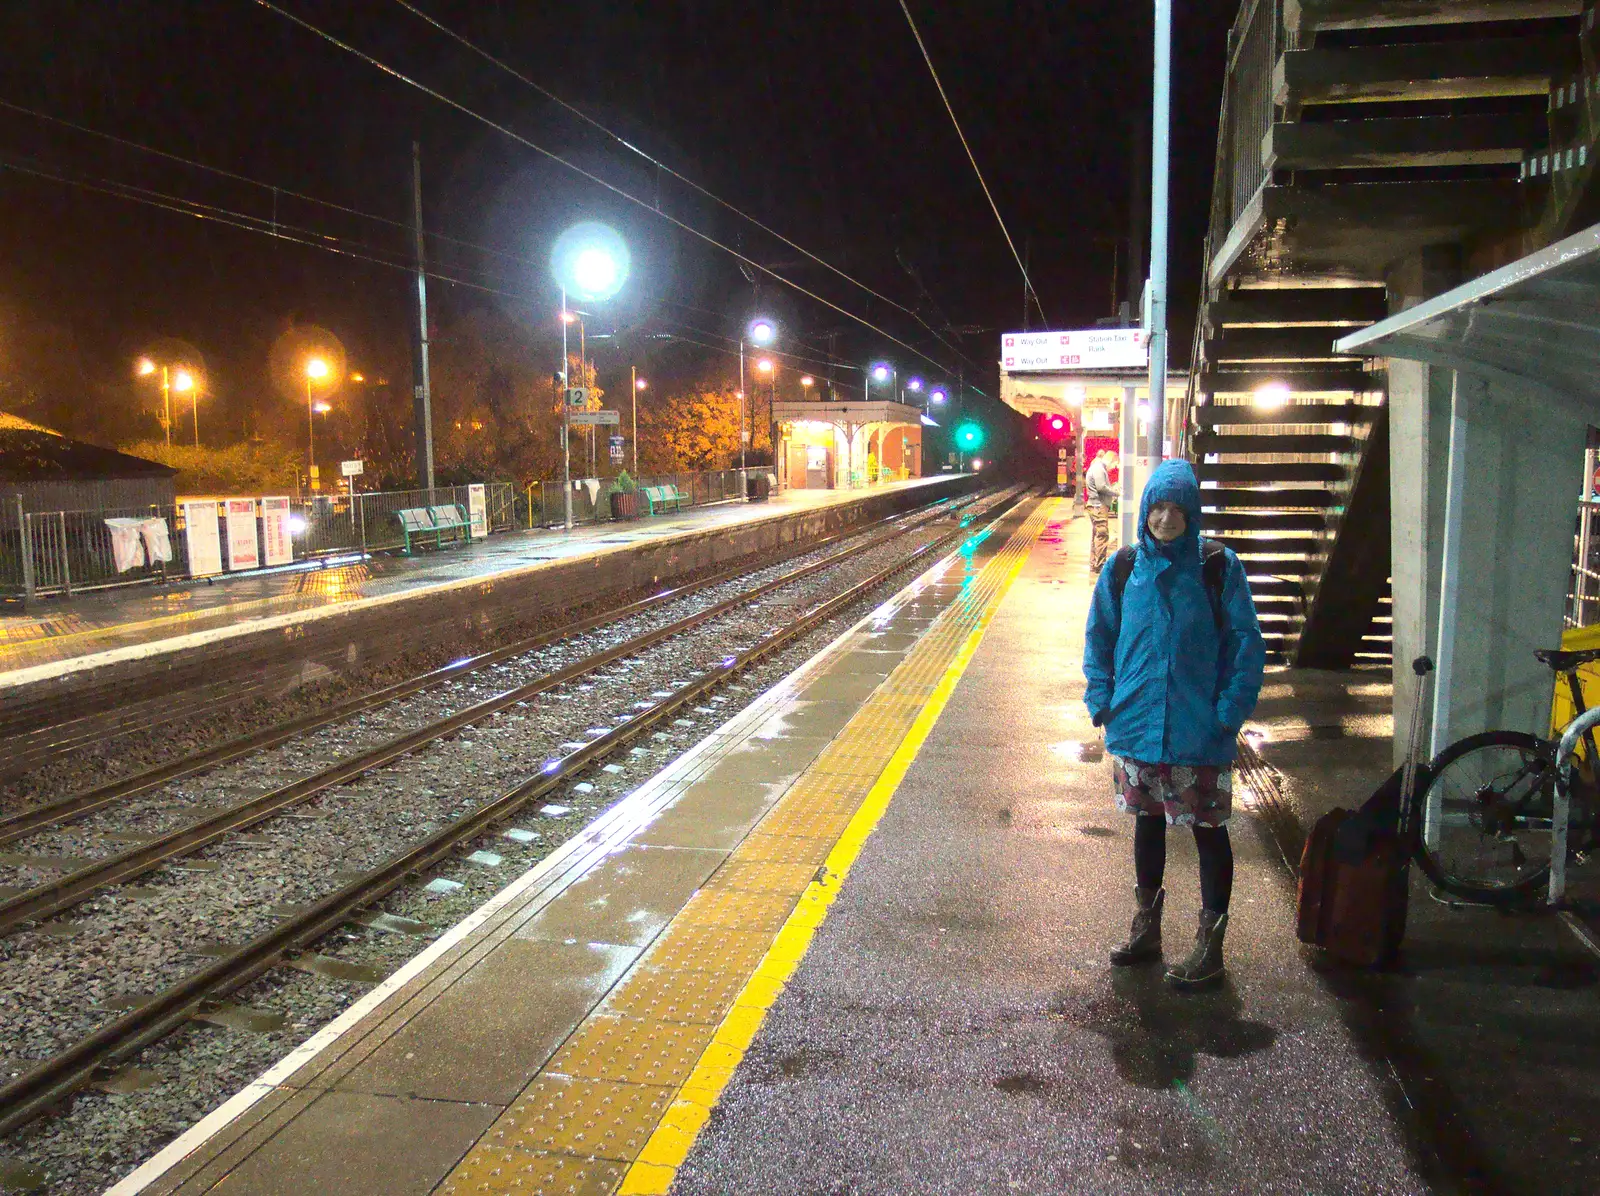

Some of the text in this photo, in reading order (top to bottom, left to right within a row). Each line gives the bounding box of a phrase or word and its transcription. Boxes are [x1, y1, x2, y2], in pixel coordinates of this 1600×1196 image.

[1020, 338, 1034, 346] Way
[1088, 335, 1112, 343] Station
[574, 390, 583, 404] 2
